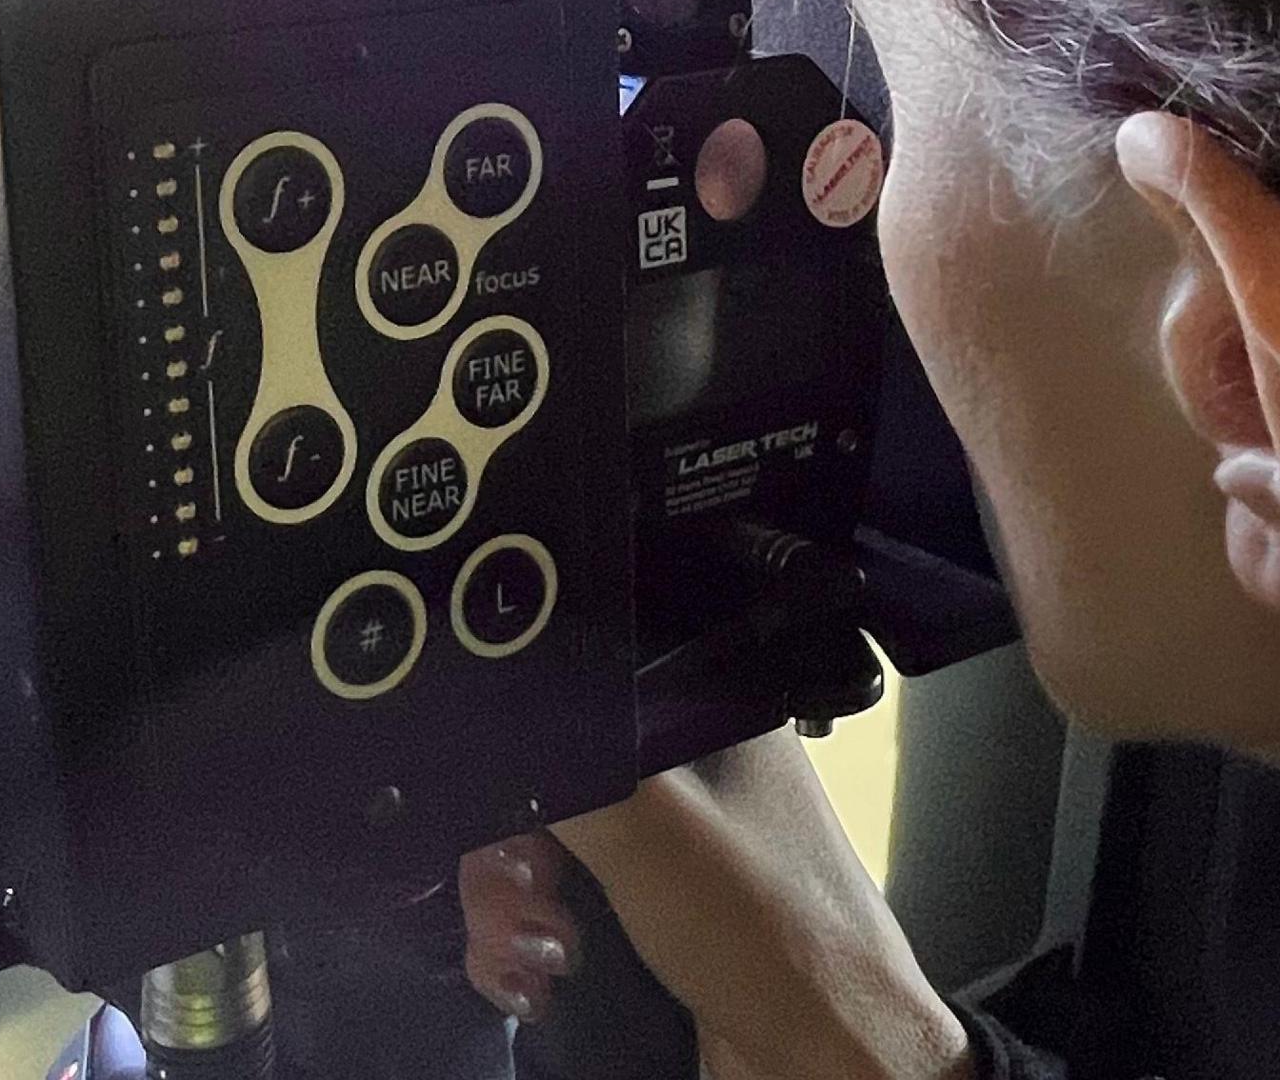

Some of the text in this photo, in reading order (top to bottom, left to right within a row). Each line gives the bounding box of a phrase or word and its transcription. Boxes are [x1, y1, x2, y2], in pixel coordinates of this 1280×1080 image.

[465, 153, 513, 183] FAR
[644, 210, 682, 238] UK
[644, 238, 683, 263] CA
[381, 260, 452, 293] NEAR
[475, 265, 540, 295] focus
[468, 350, 526, 381] FINE
[476, 379, 523, 412] FAR
[678, 439, 759, 475] LASER
[760, 421, 819, 451] TECH
[395, 457, 457, 493] FINE
[392, 486, 461, 521] NEAR
[495, 582, 517, 614] L
[360, 620, 383, 653] #
